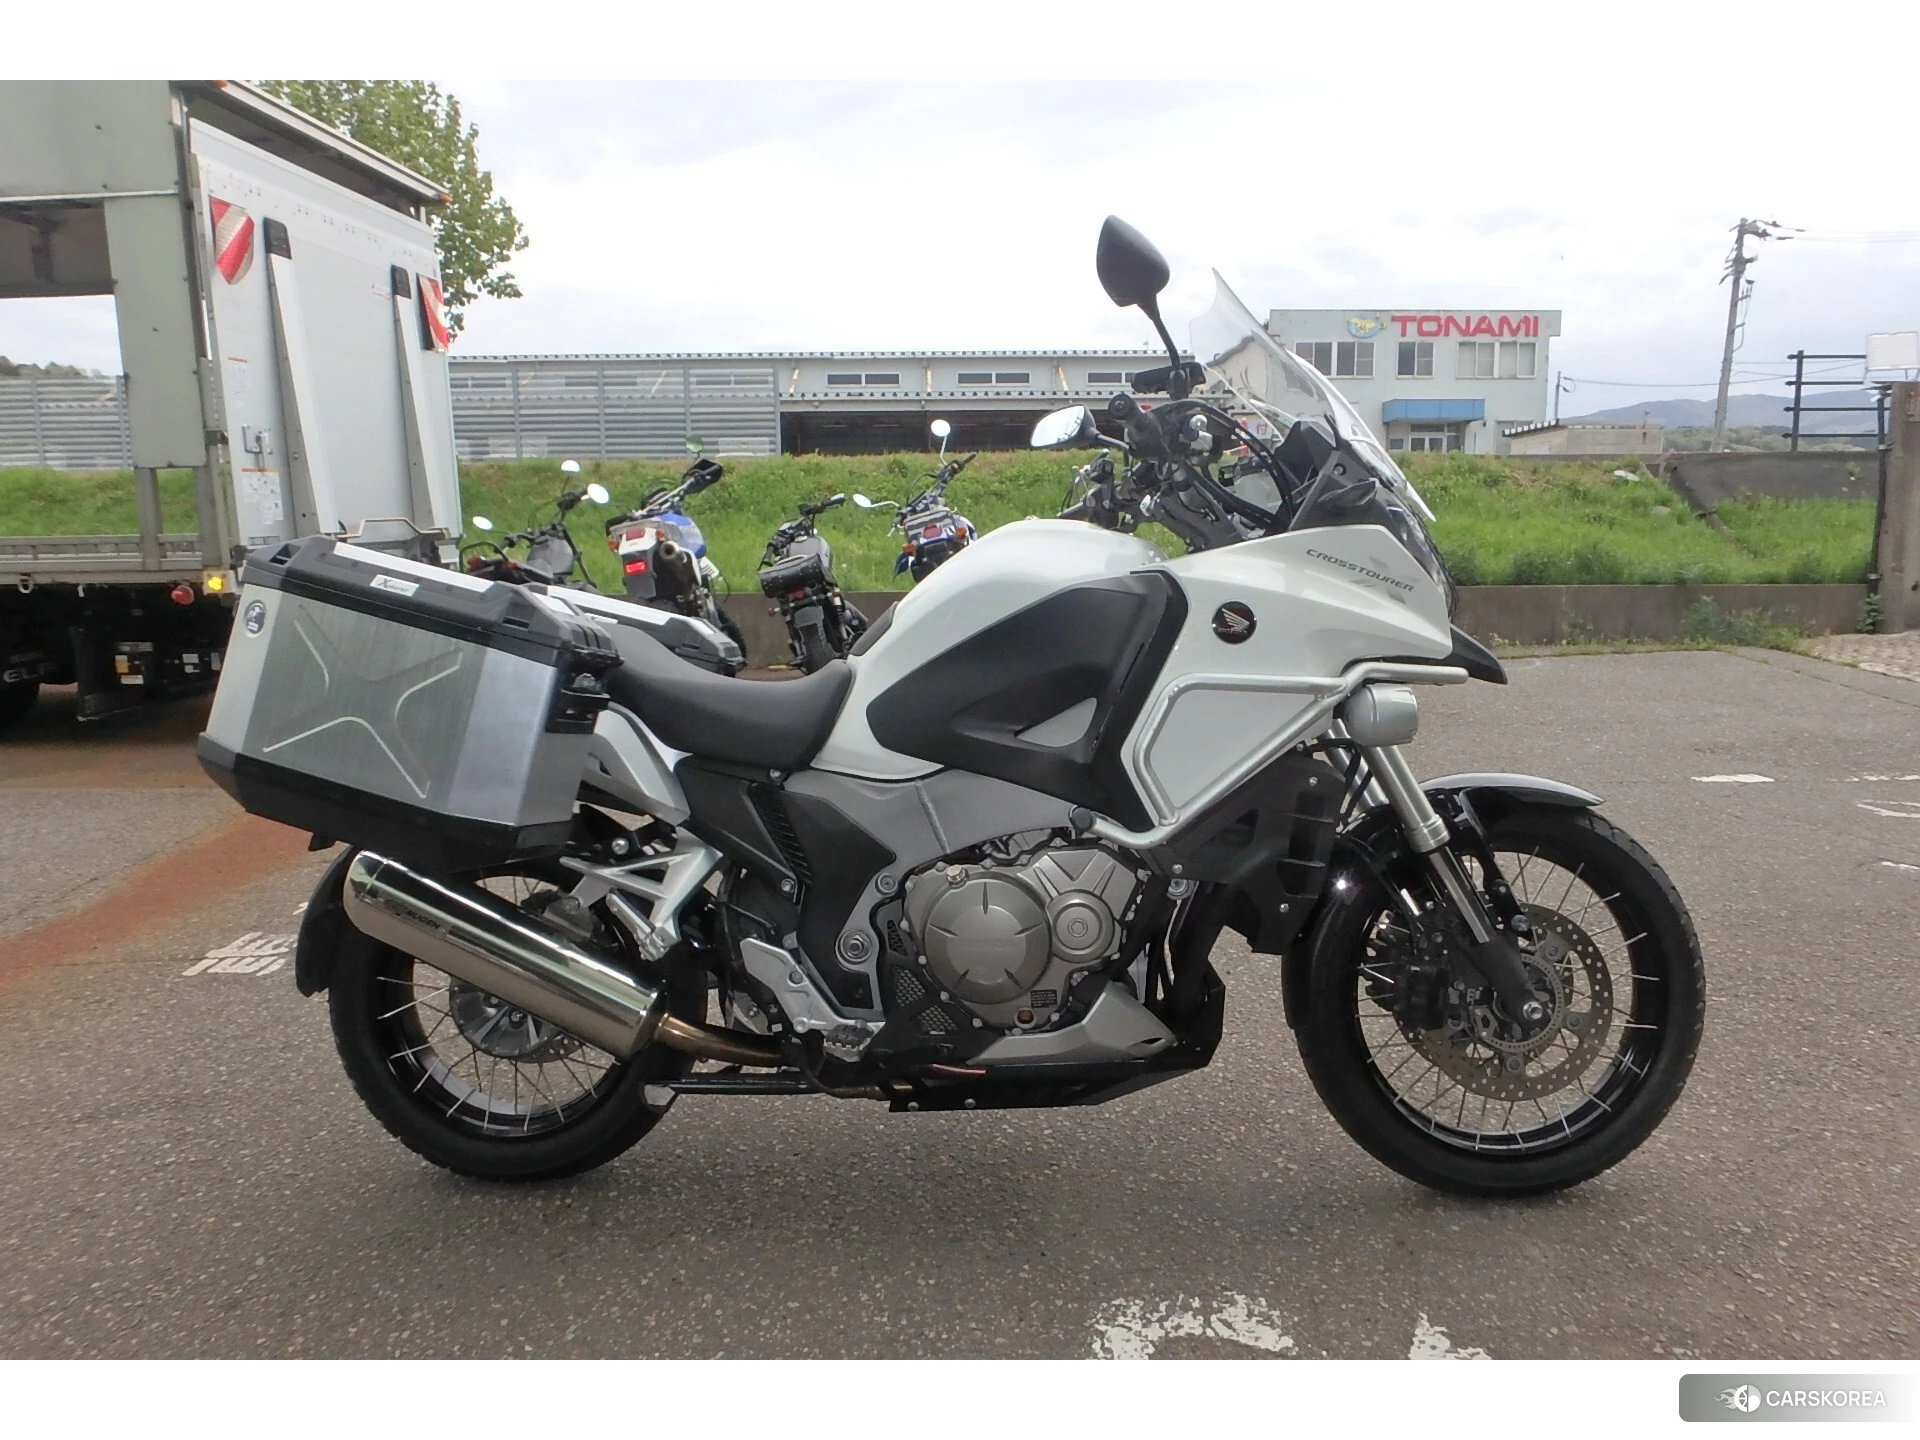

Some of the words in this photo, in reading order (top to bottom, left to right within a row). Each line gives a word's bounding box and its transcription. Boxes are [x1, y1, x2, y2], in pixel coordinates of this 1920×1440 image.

[1391, 315, 1539, 337] TONAMI
[1306, 548, 1415, 592] CROSSTOURER
[406, 909, 441, 930] MUGEN
